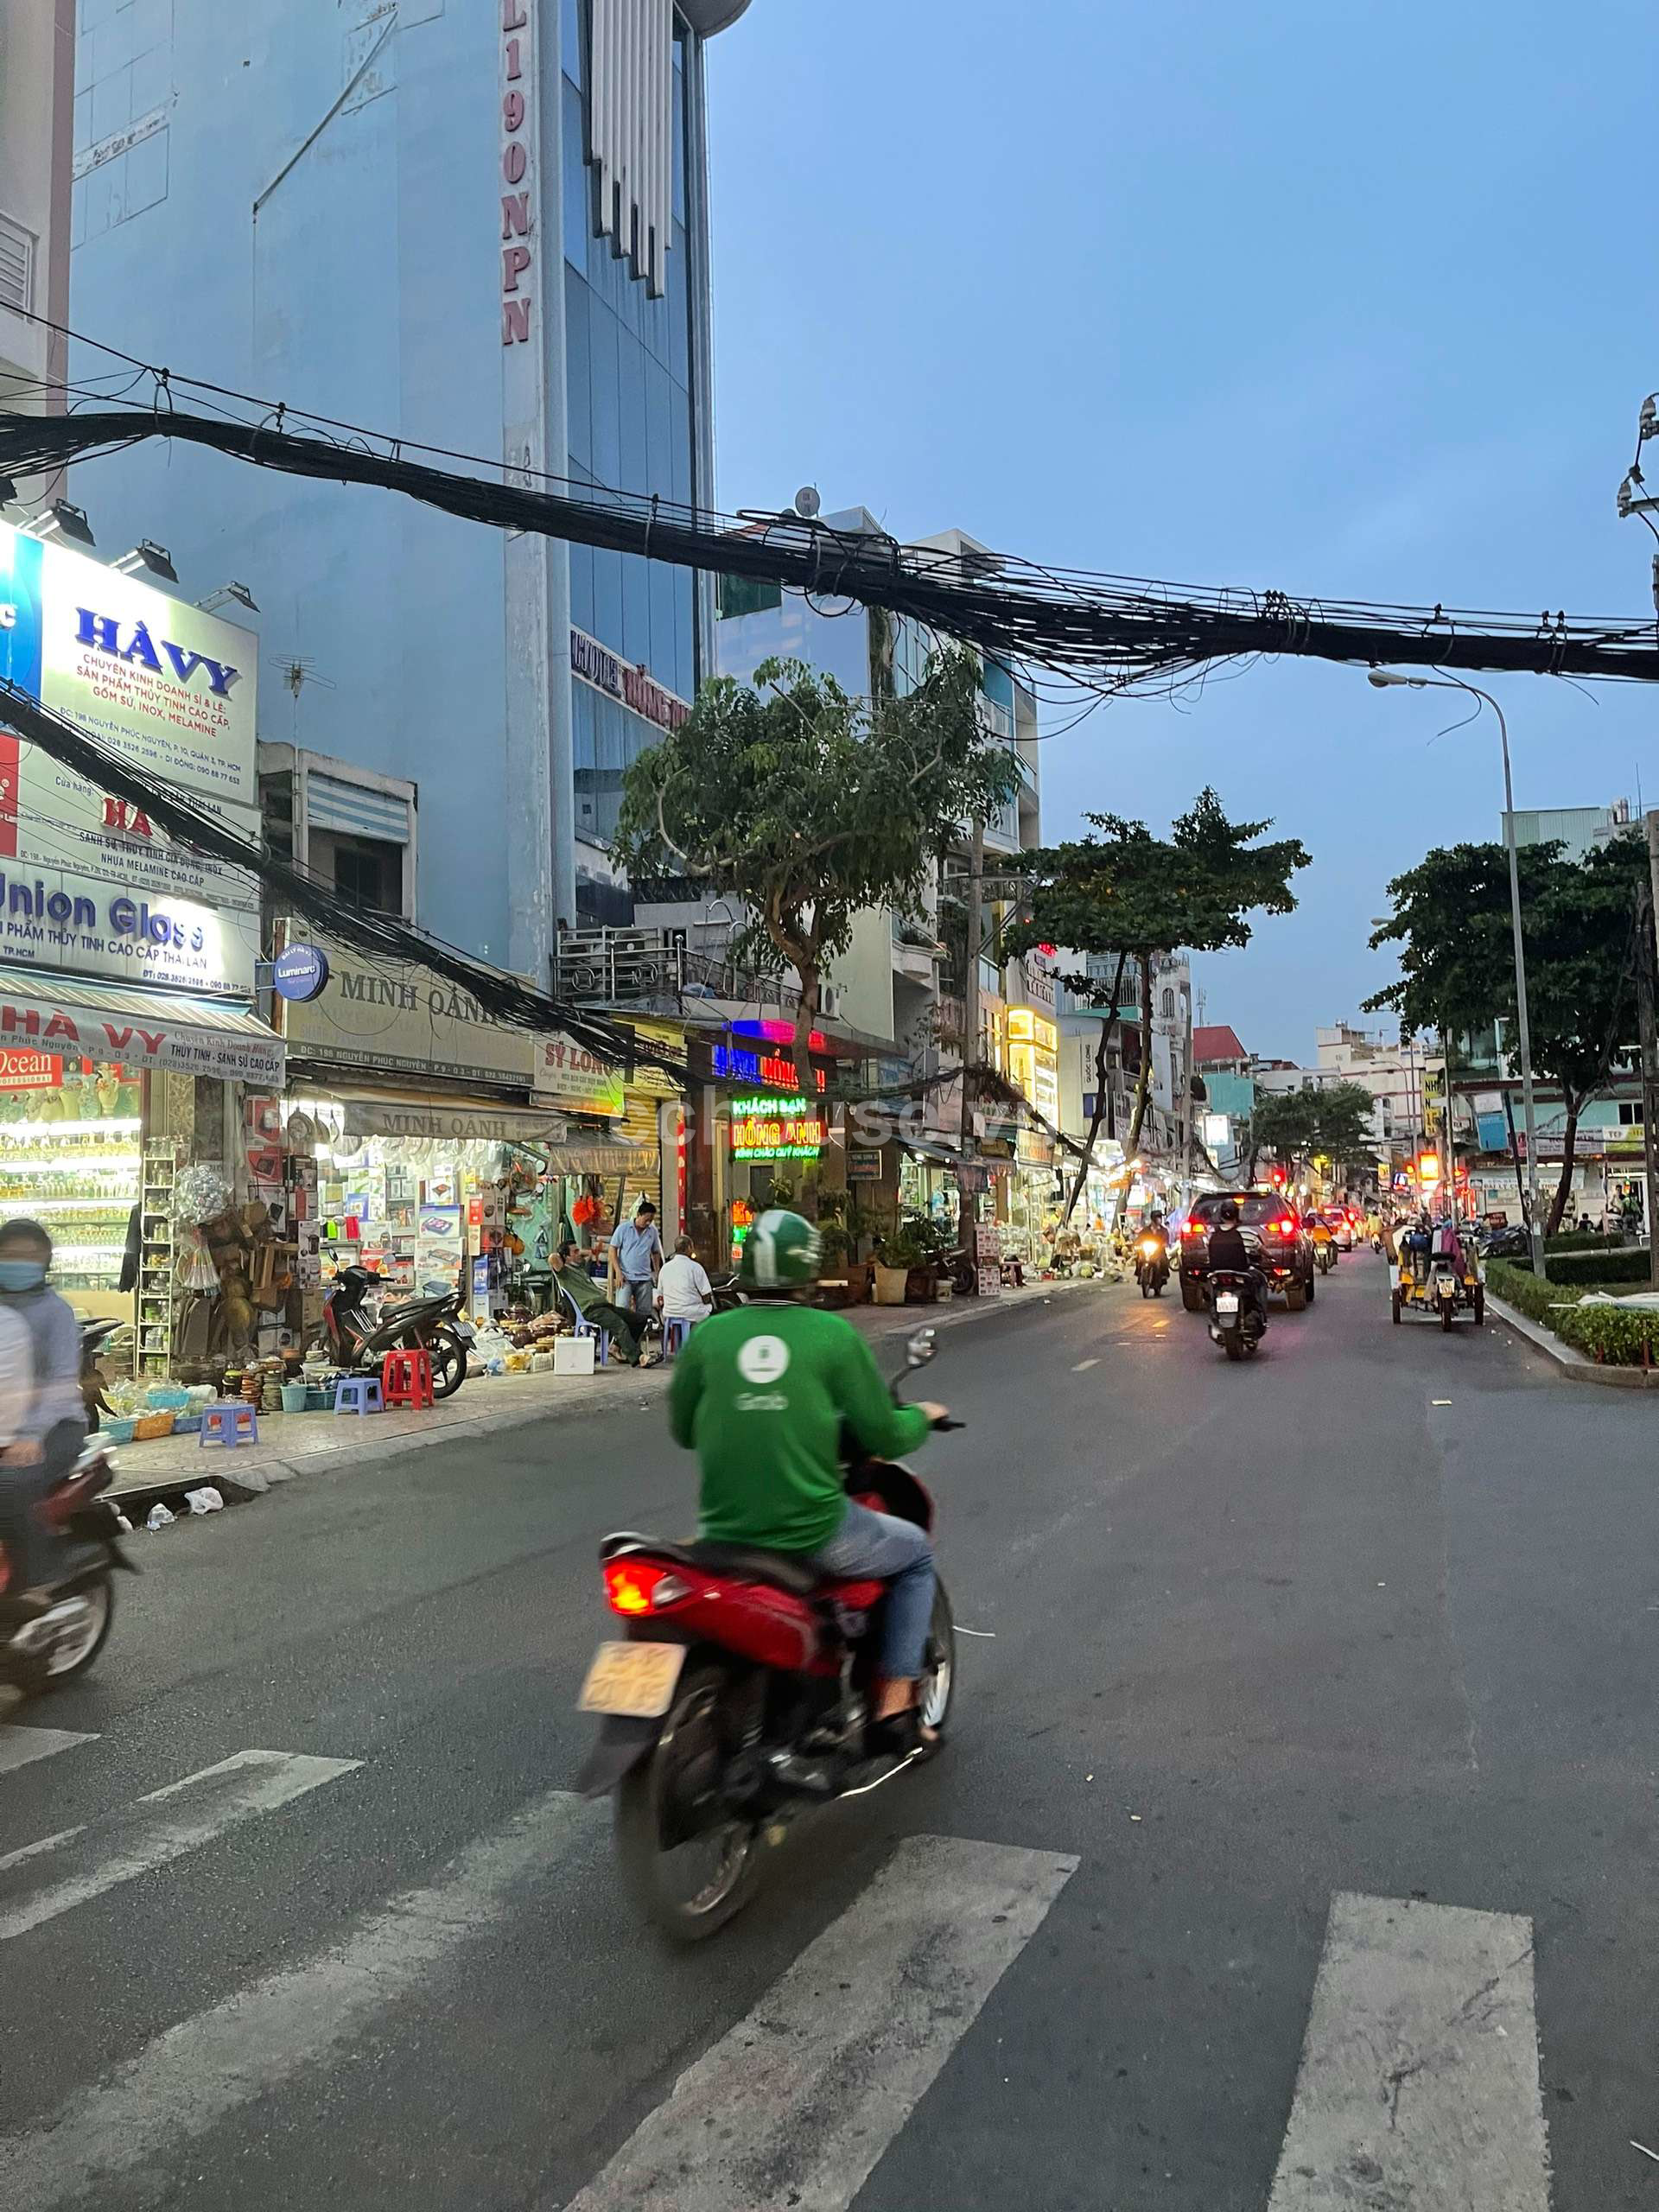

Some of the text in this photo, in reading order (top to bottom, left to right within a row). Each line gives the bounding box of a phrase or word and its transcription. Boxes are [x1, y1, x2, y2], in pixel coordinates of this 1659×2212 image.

[83, 653, 127, 677] CHUYÊN
[129, 669, 154, 688] KINH
[156, 680, 191, 702] DOANH
[204, 698, 210, 708] &
[138, 702, 166, 721] INOX,
[168, 712, 217, 738] MELAMINE
[163, 696, 186, 713] TINH
[188, 707, 208, 721] CAO
[126, 858, 169, 878] MELAMINE
[171, 870, 188, 882] CAO
[0, 872, 96, 928] nion
[7, 919, 44, 941] PHẨM
[48, 927, 77, 948] THỦY
[81, 935, 105, 952] TINH
[107, 941, 134, 957] CAO
[277, 965, 316, 978] Luminarc
[340, 970, 419, 1012] MINH
[2, 1005, 167, 1055] HÀ VY
[193, 1048, 211, 1062] TINH
[250, 1058, 264, 1071] CAO
[733, 1096, 807, 1115] KHÁCH SẠN
[383, 1113, 444, 1135] MINH
[451, 1114, 506, 1135] OÁNH
[733, 1115, 822, 1147] HỒNG ANH
